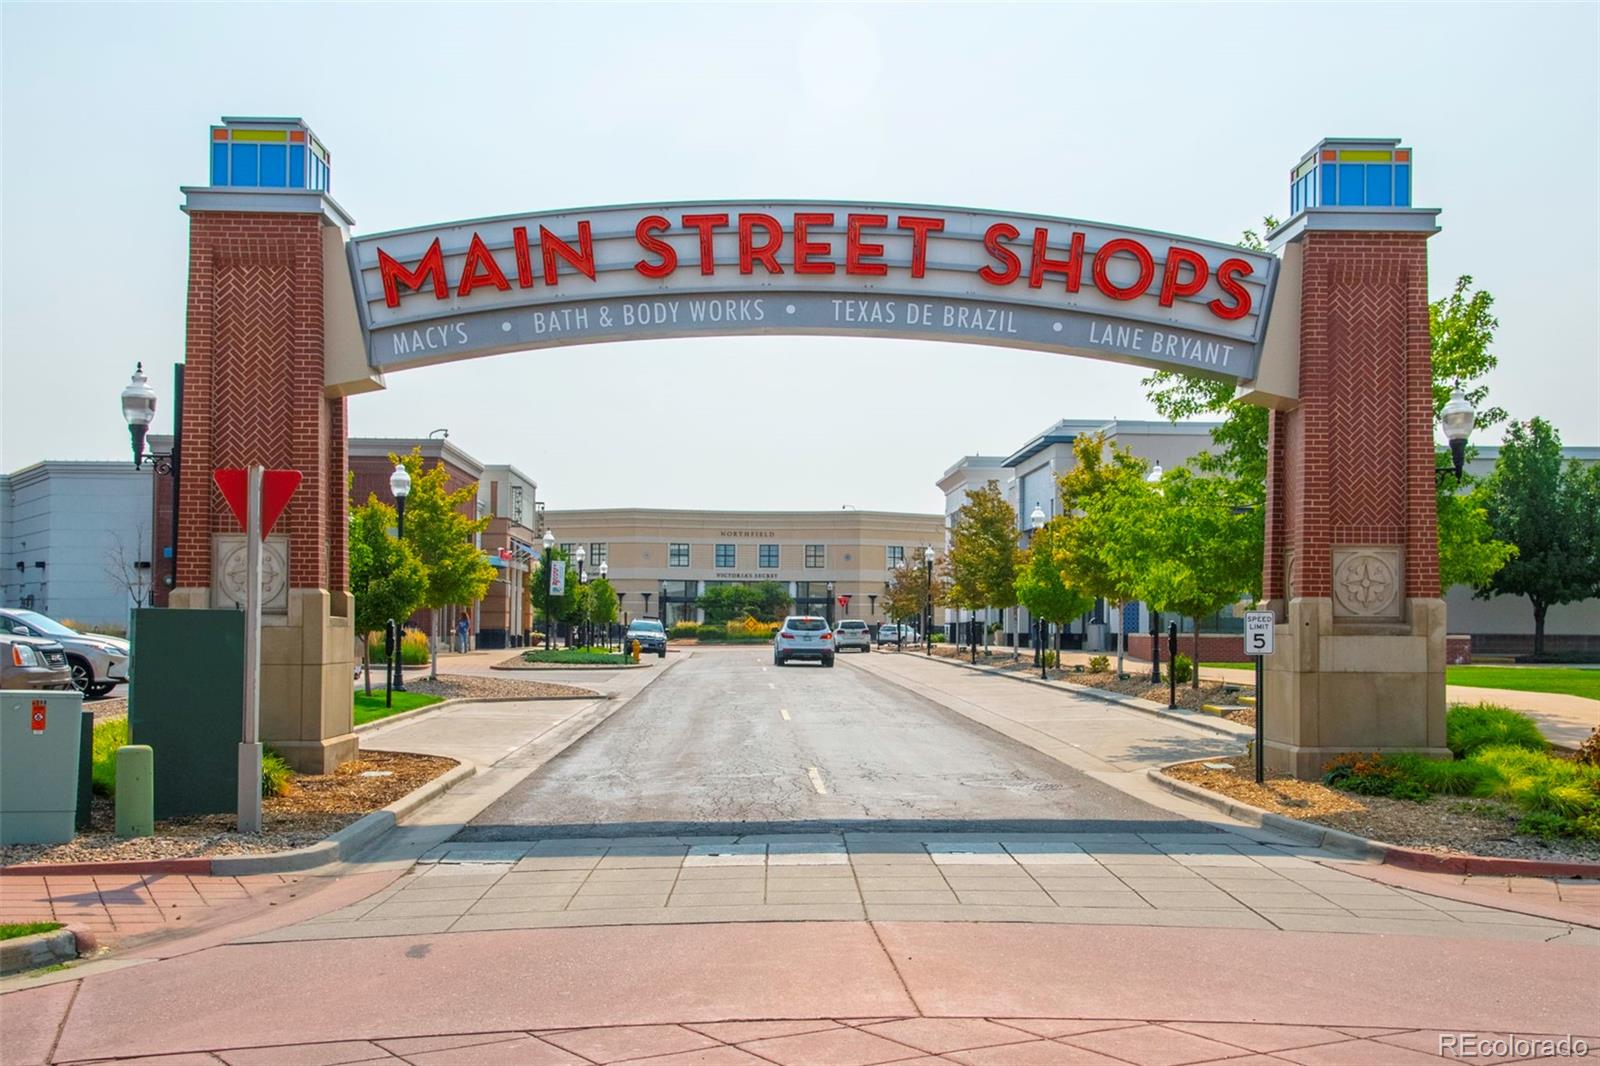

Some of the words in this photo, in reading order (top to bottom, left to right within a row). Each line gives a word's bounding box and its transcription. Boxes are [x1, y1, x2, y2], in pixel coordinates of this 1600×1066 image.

[376, 220, 597, 309] MAIN
[634, 212, 945, 279] STREET
[978, 222, 1254, 320] SHOPS
[533, 306, 589, 334] BATH
[599, 306, 614, 328] &
[623, 300, 680, 326] BODY
[690, 298, 766, 322] WORKS
[832, 299, 896, 324] TEXAS
[906, 303, 933, 326] DE
[943, 305, 1018, 334] BRAZIL
[393, 321, 468, 355] MACY'S
[1089, 321, 1145, 350] LANE
[1151, 328, 1234, 368] BRYANT
[1253, 633, 1266, 648] 5
